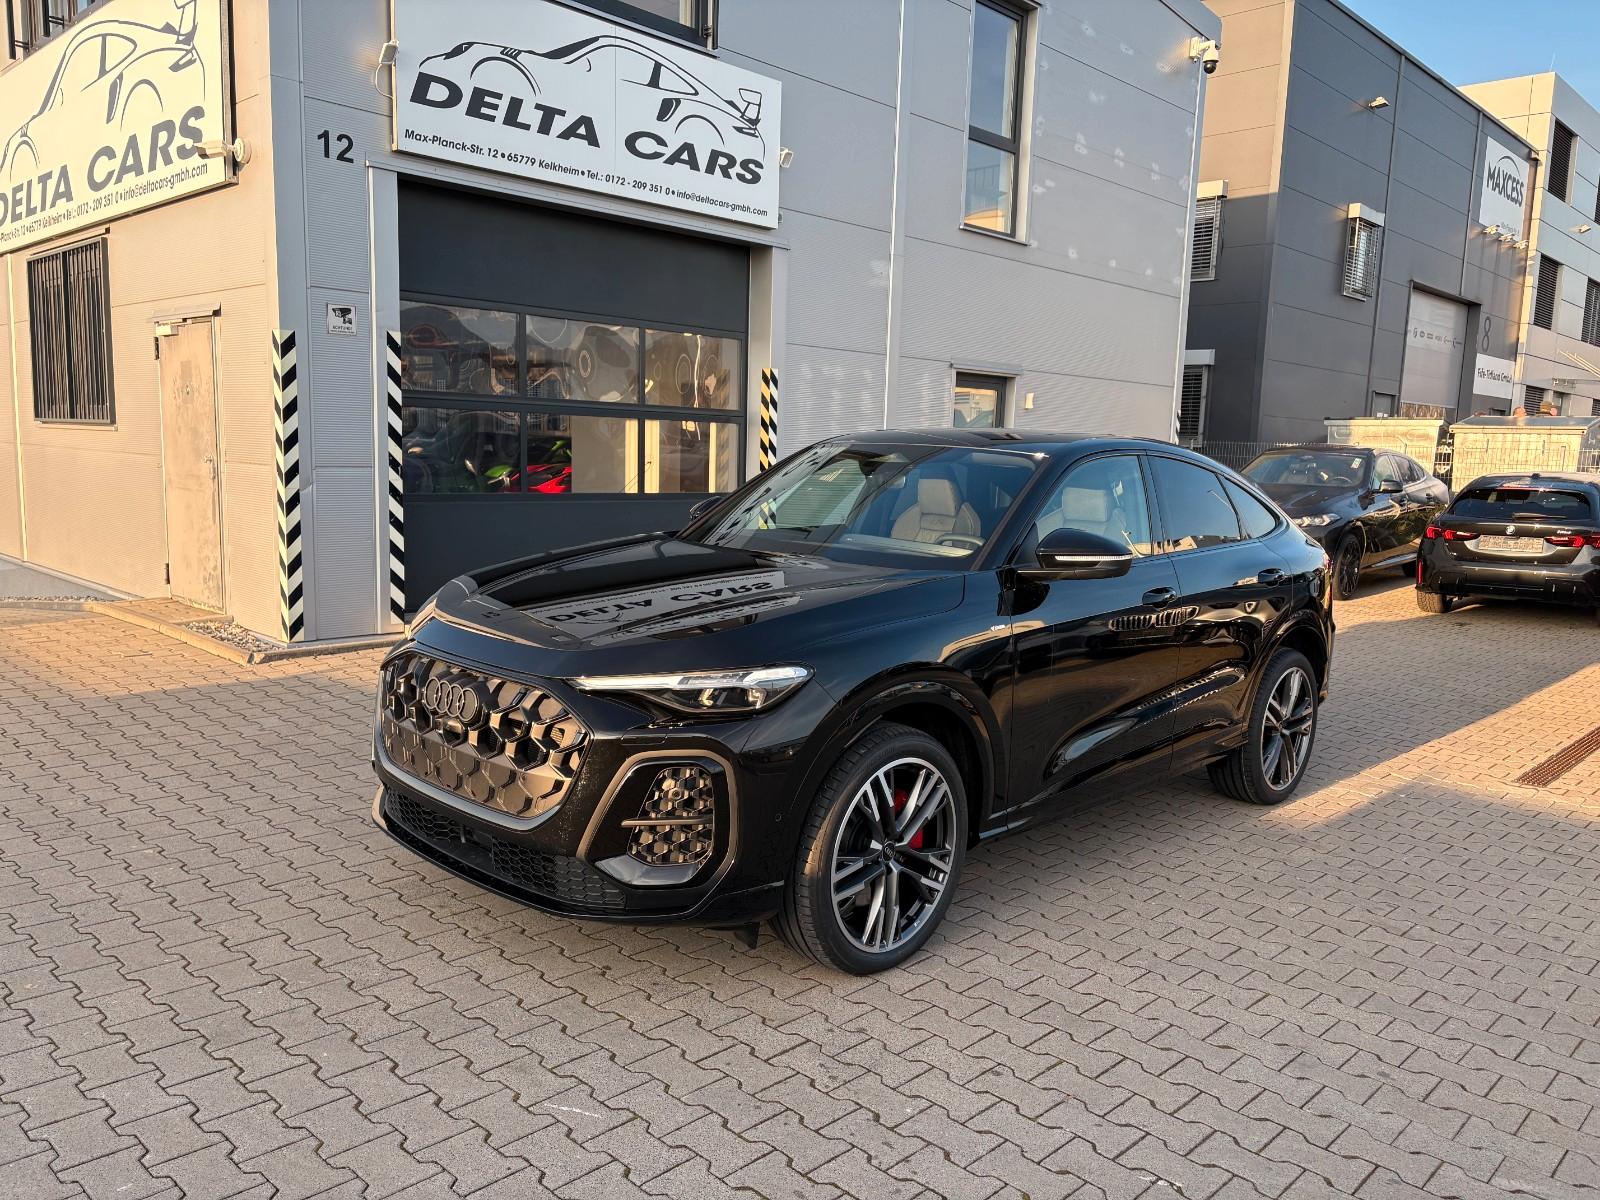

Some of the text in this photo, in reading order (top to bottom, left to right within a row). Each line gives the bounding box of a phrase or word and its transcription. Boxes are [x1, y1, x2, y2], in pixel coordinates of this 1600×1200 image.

[317, 129, 355, 164] 12
[409, 71, 765, 186] DELTA CARS
[0, 105, 205, 228] DELTA CARS
[404, 128, 485, 156] Max-Planck-Str.
[487, 147, 499, 159] 12
[507, 152, 536, 167] 65779
[538, 159, 580, 176] Kelkheim
[587, 169, 604, 182] Tel.:
[605, 173, 626, 186] 0172
[632, 180, 647, 191] 209
[648, 183, 663, 194] 351
[676, 189, 768, 217] info@deltacars-gmbh.com
[1487, 161, 1524, 208] MAXCESS
[1482, 315, 1491, 353] 8
